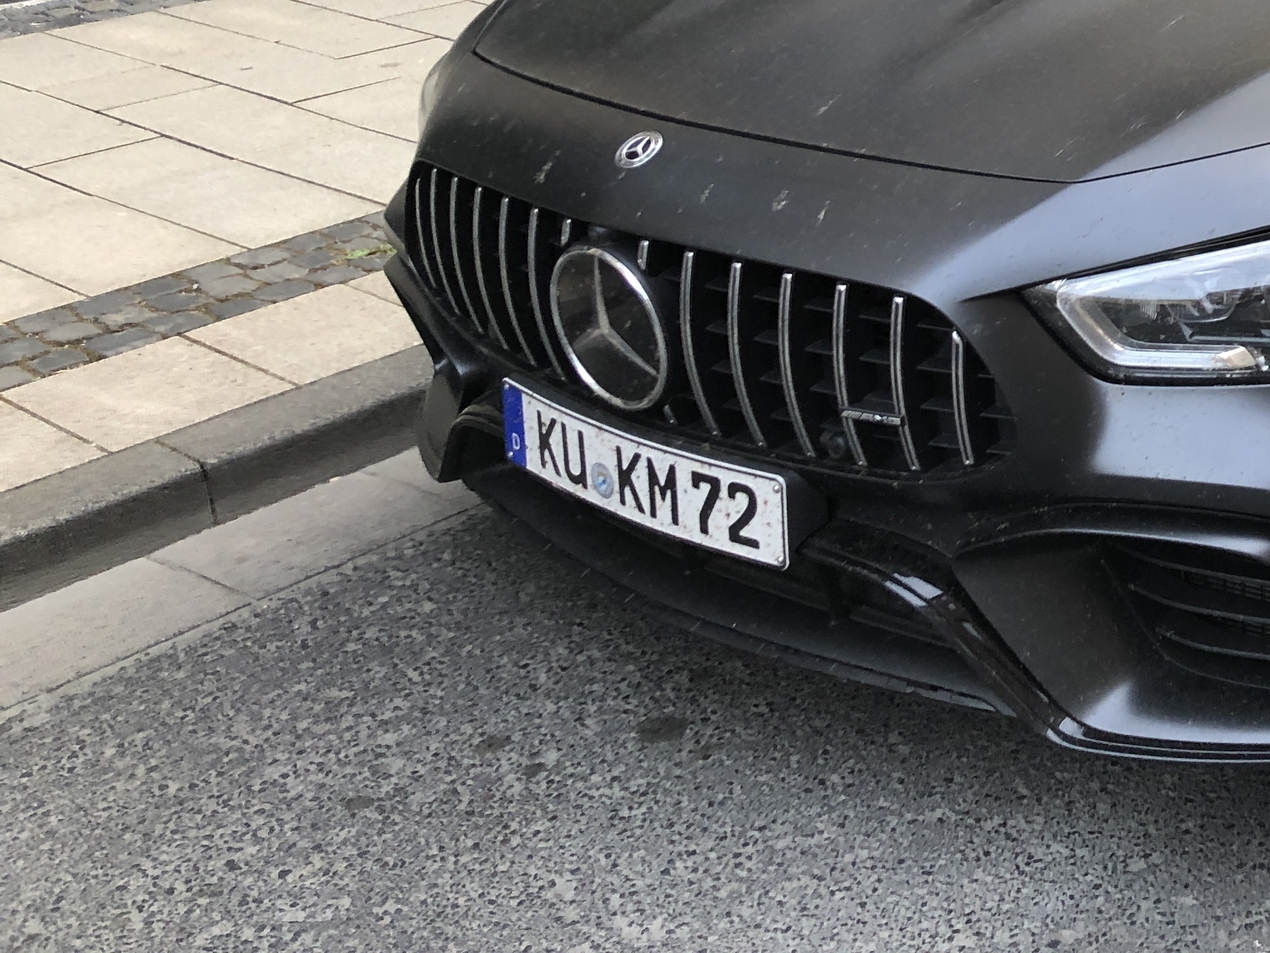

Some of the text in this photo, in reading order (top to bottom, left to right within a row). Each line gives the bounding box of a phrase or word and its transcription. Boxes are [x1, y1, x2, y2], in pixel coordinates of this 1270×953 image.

[511, 432, 521, 450] D
[536, 410, 761, 550] KU KM 72
